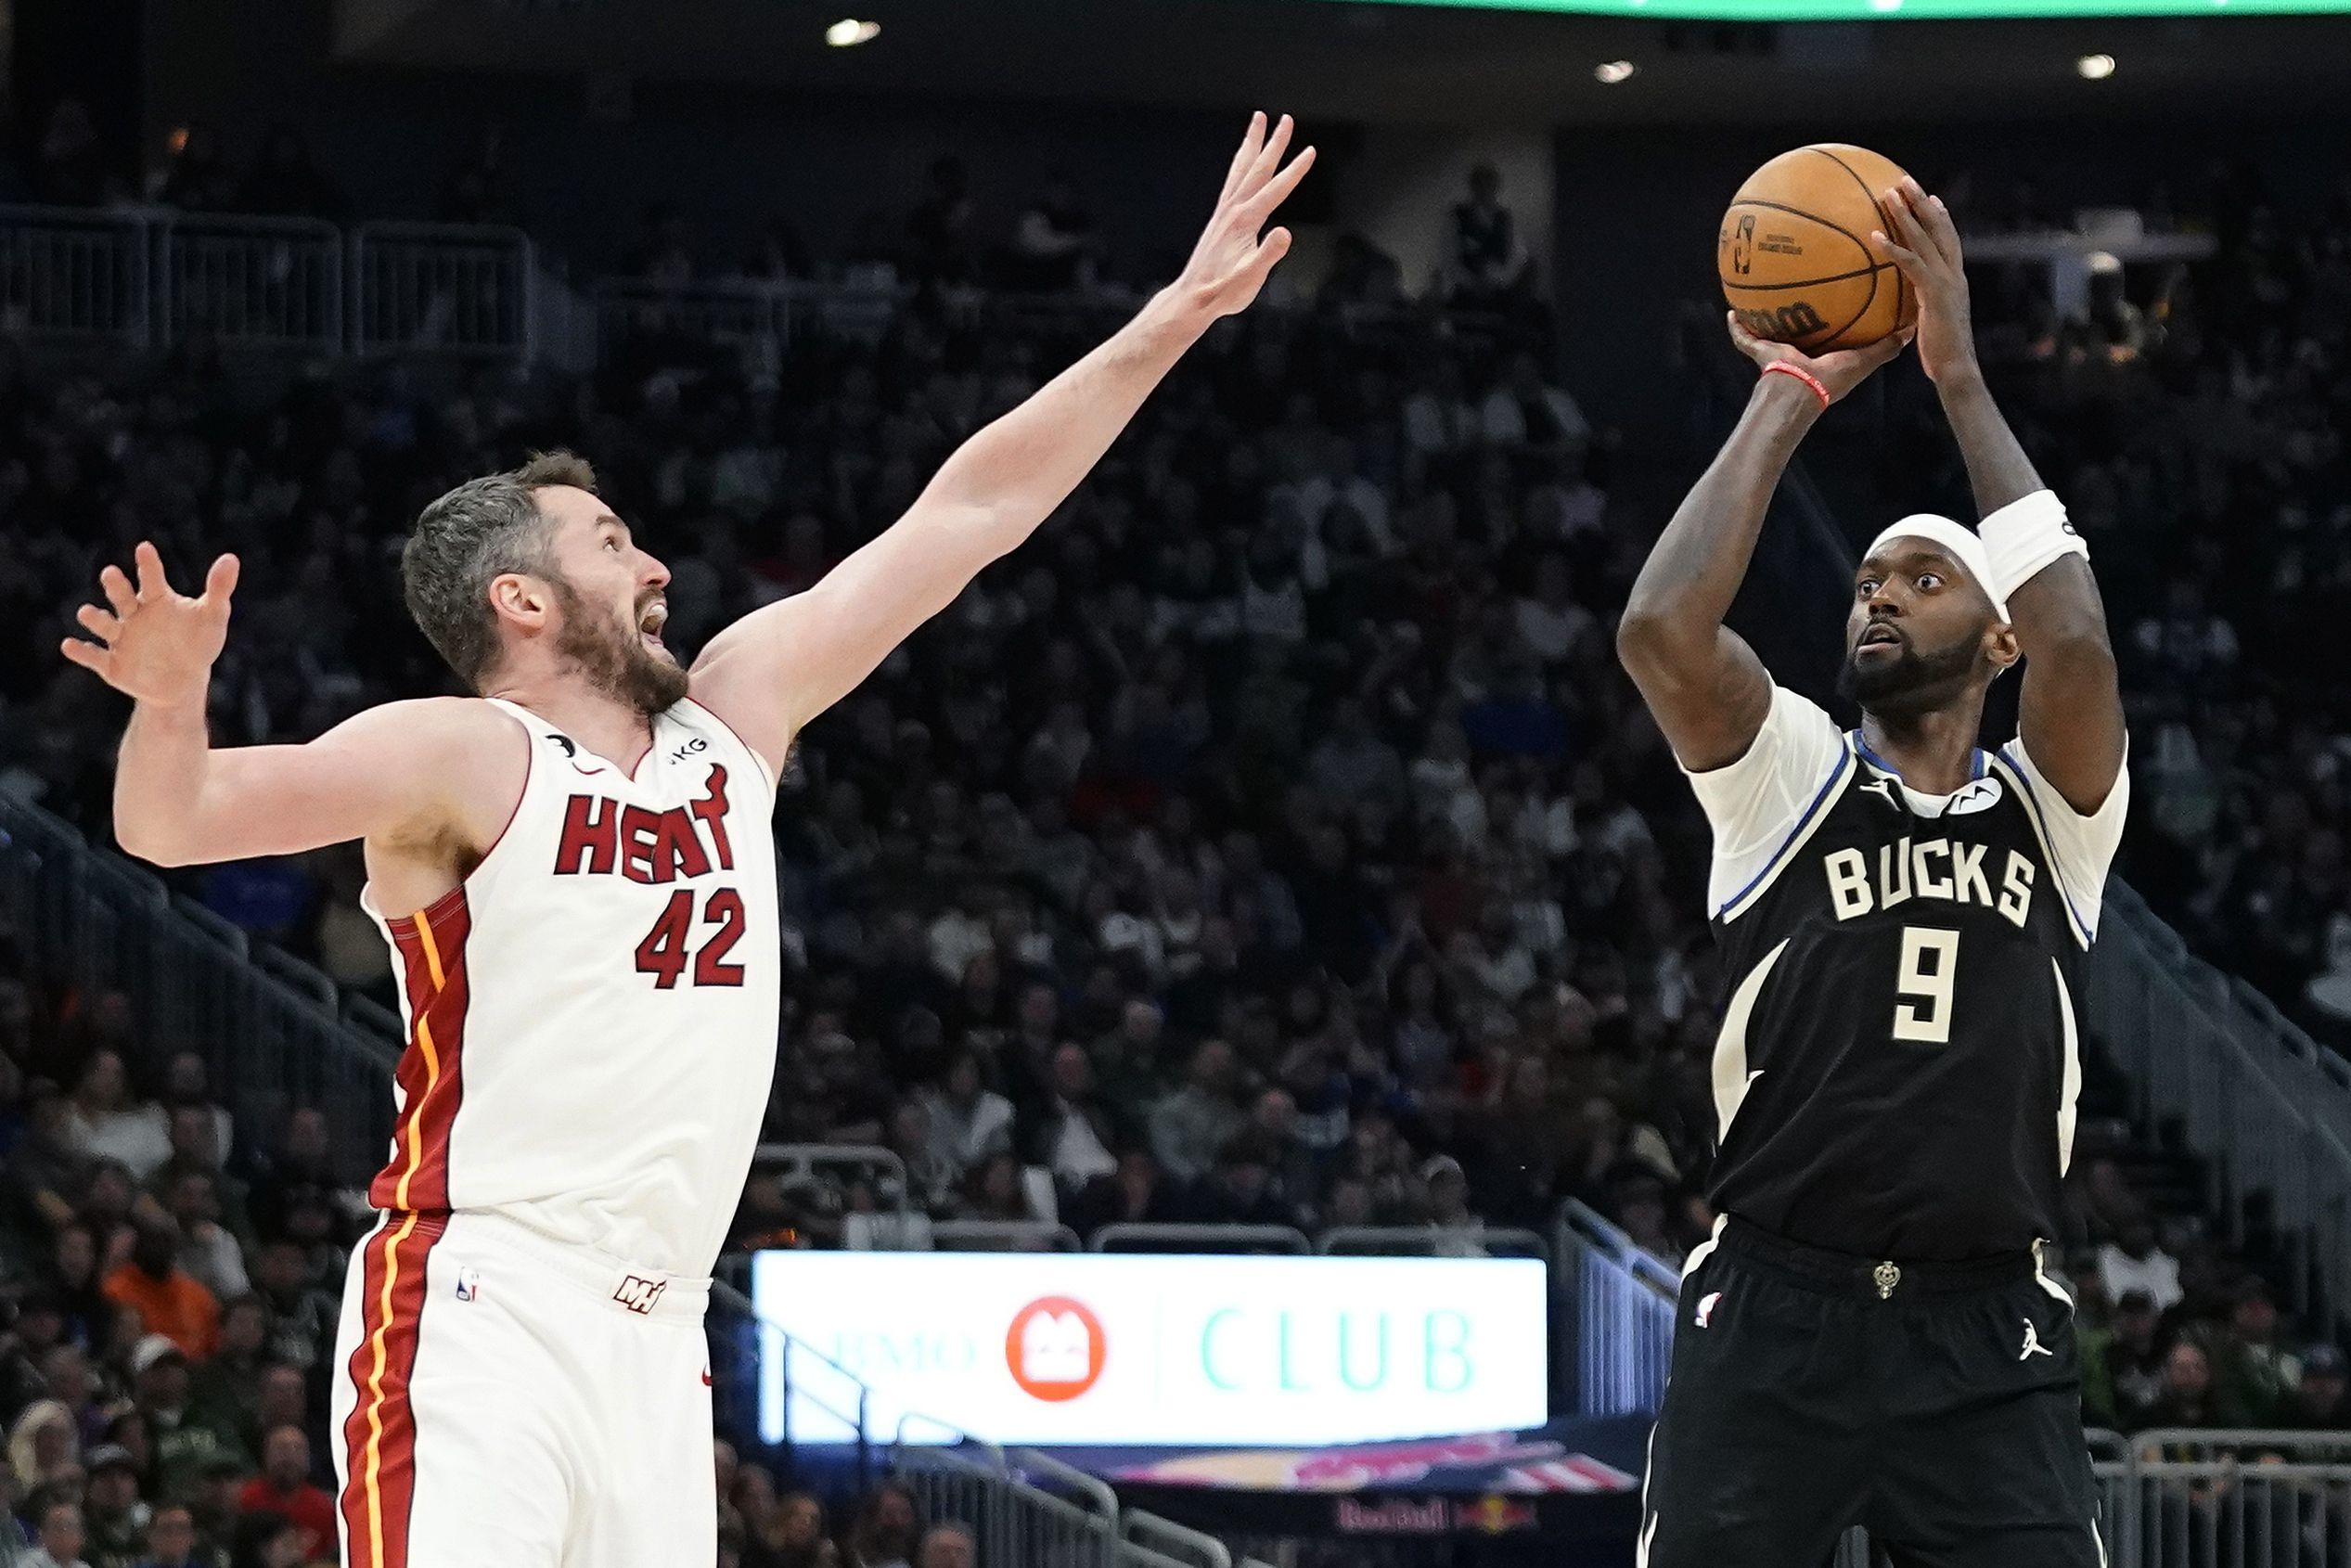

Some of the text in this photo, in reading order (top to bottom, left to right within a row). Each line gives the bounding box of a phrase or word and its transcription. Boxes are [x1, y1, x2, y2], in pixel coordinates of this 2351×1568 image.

[553, 763, 735, 884] HEAT
[1824, 836, 2036, 928] BUCKS
[635, 887, 746, 989] 42
[1893, 926, 1960, 1043] 9
[832, 1305, 1478, 1394] BMO CLUB
